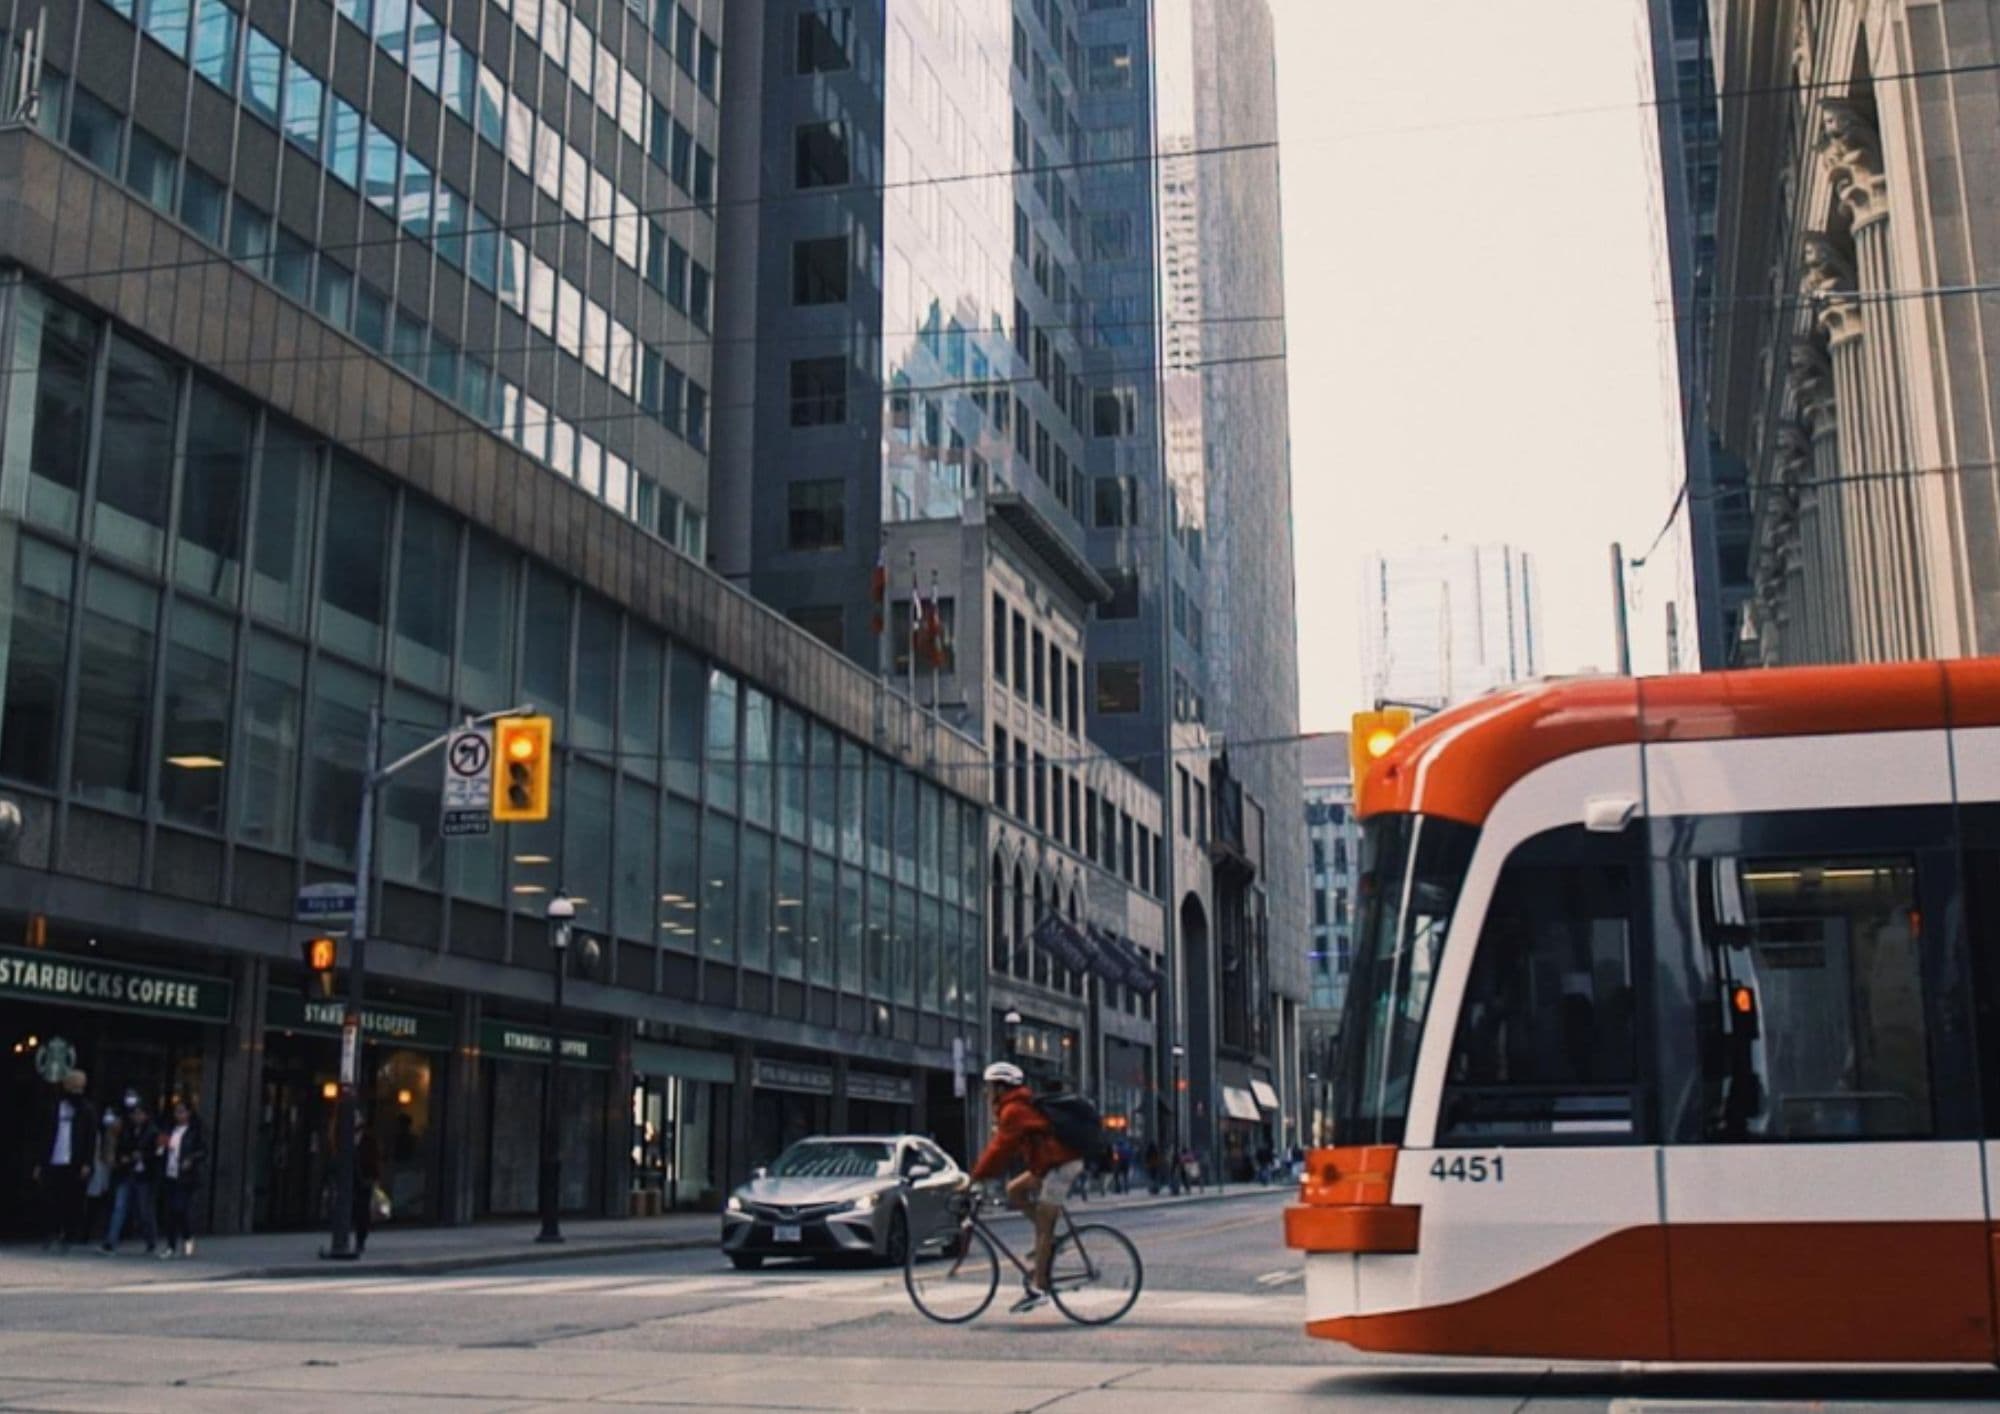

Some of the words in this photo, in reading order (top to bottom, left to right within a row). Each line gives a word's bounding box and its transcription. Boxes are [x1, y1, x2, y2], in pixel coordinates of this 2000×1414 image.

[0, 957, 123, 999] STARBUCKS
[127, 976, 199, 1009] COFFEE
[1429, 1155, 1504, 1183] 4451
